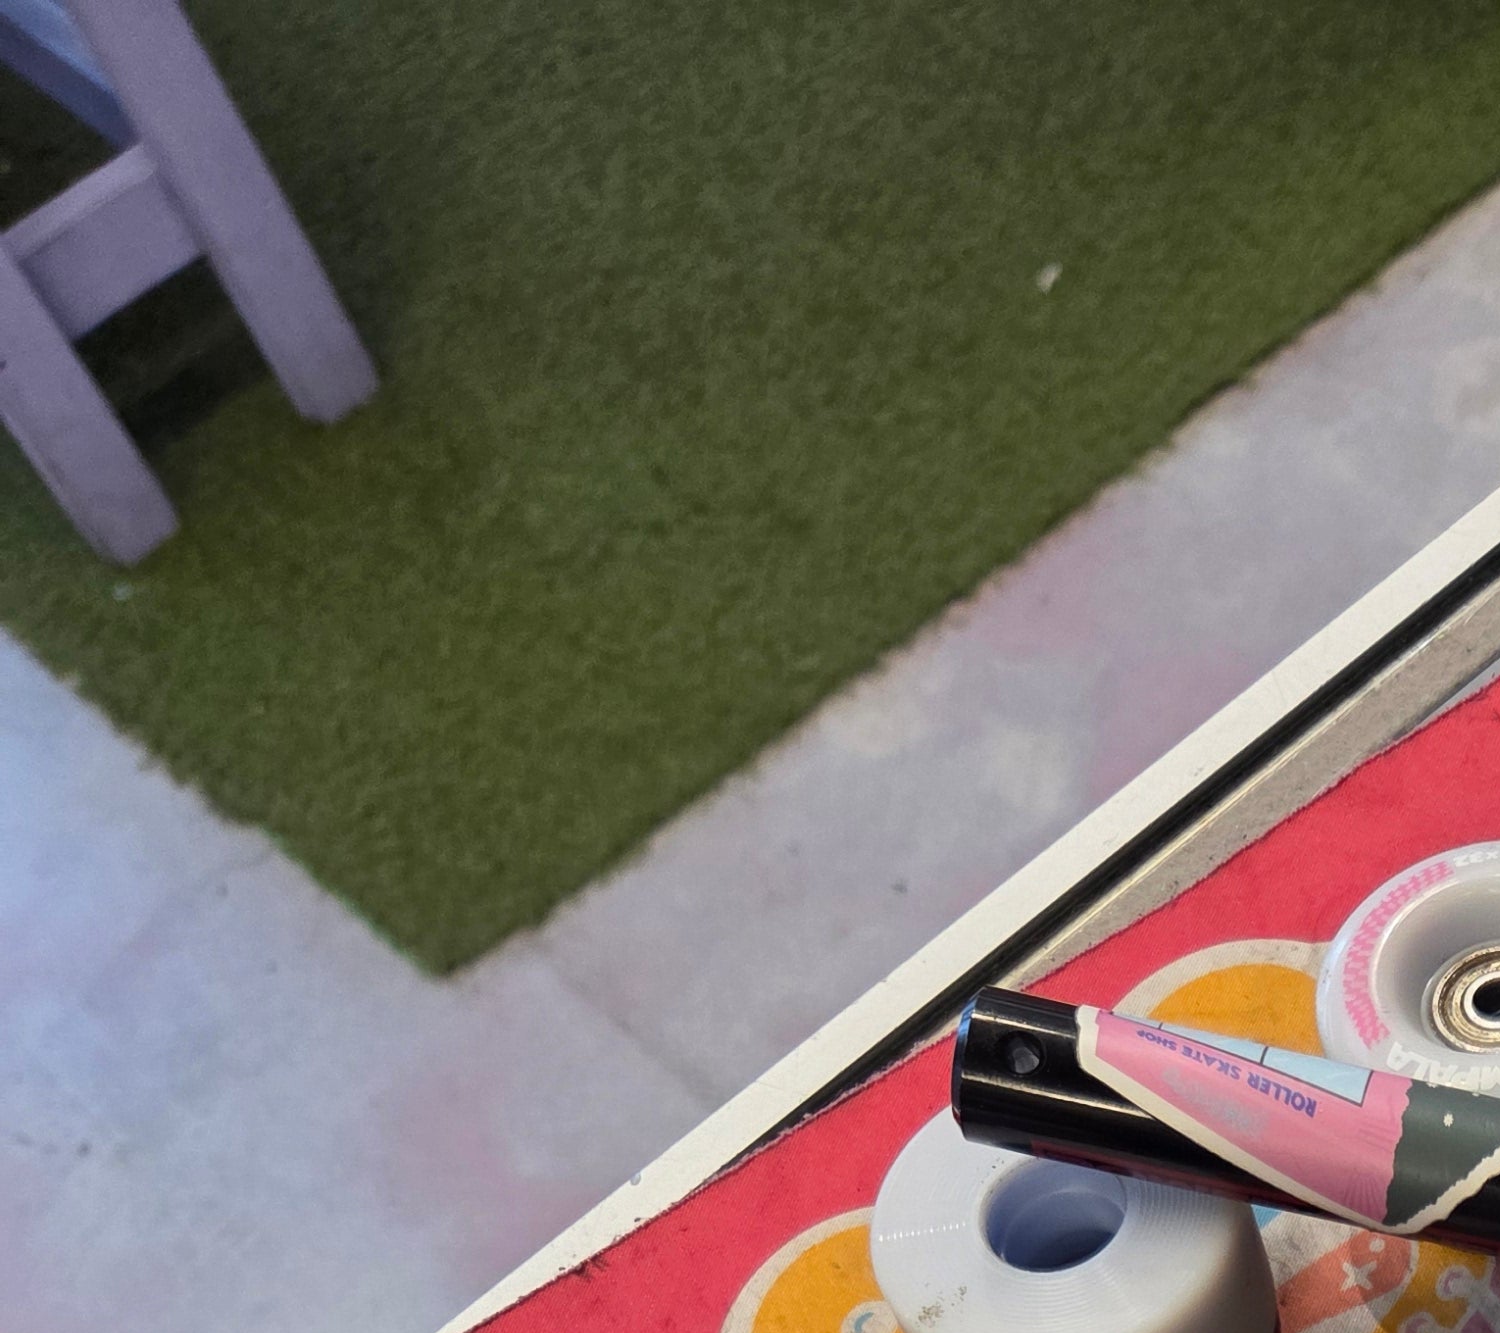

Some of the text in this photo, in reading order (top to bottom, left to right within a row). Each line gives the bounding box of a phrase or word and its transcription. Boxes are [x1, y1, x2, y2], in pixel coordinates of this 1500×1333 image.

[1137, 1029, 1178, 1051] SHOP
[1181, 1046, 1243, 1080] SKATE
[1247, 1071, 1318, 1118] ROLLER
